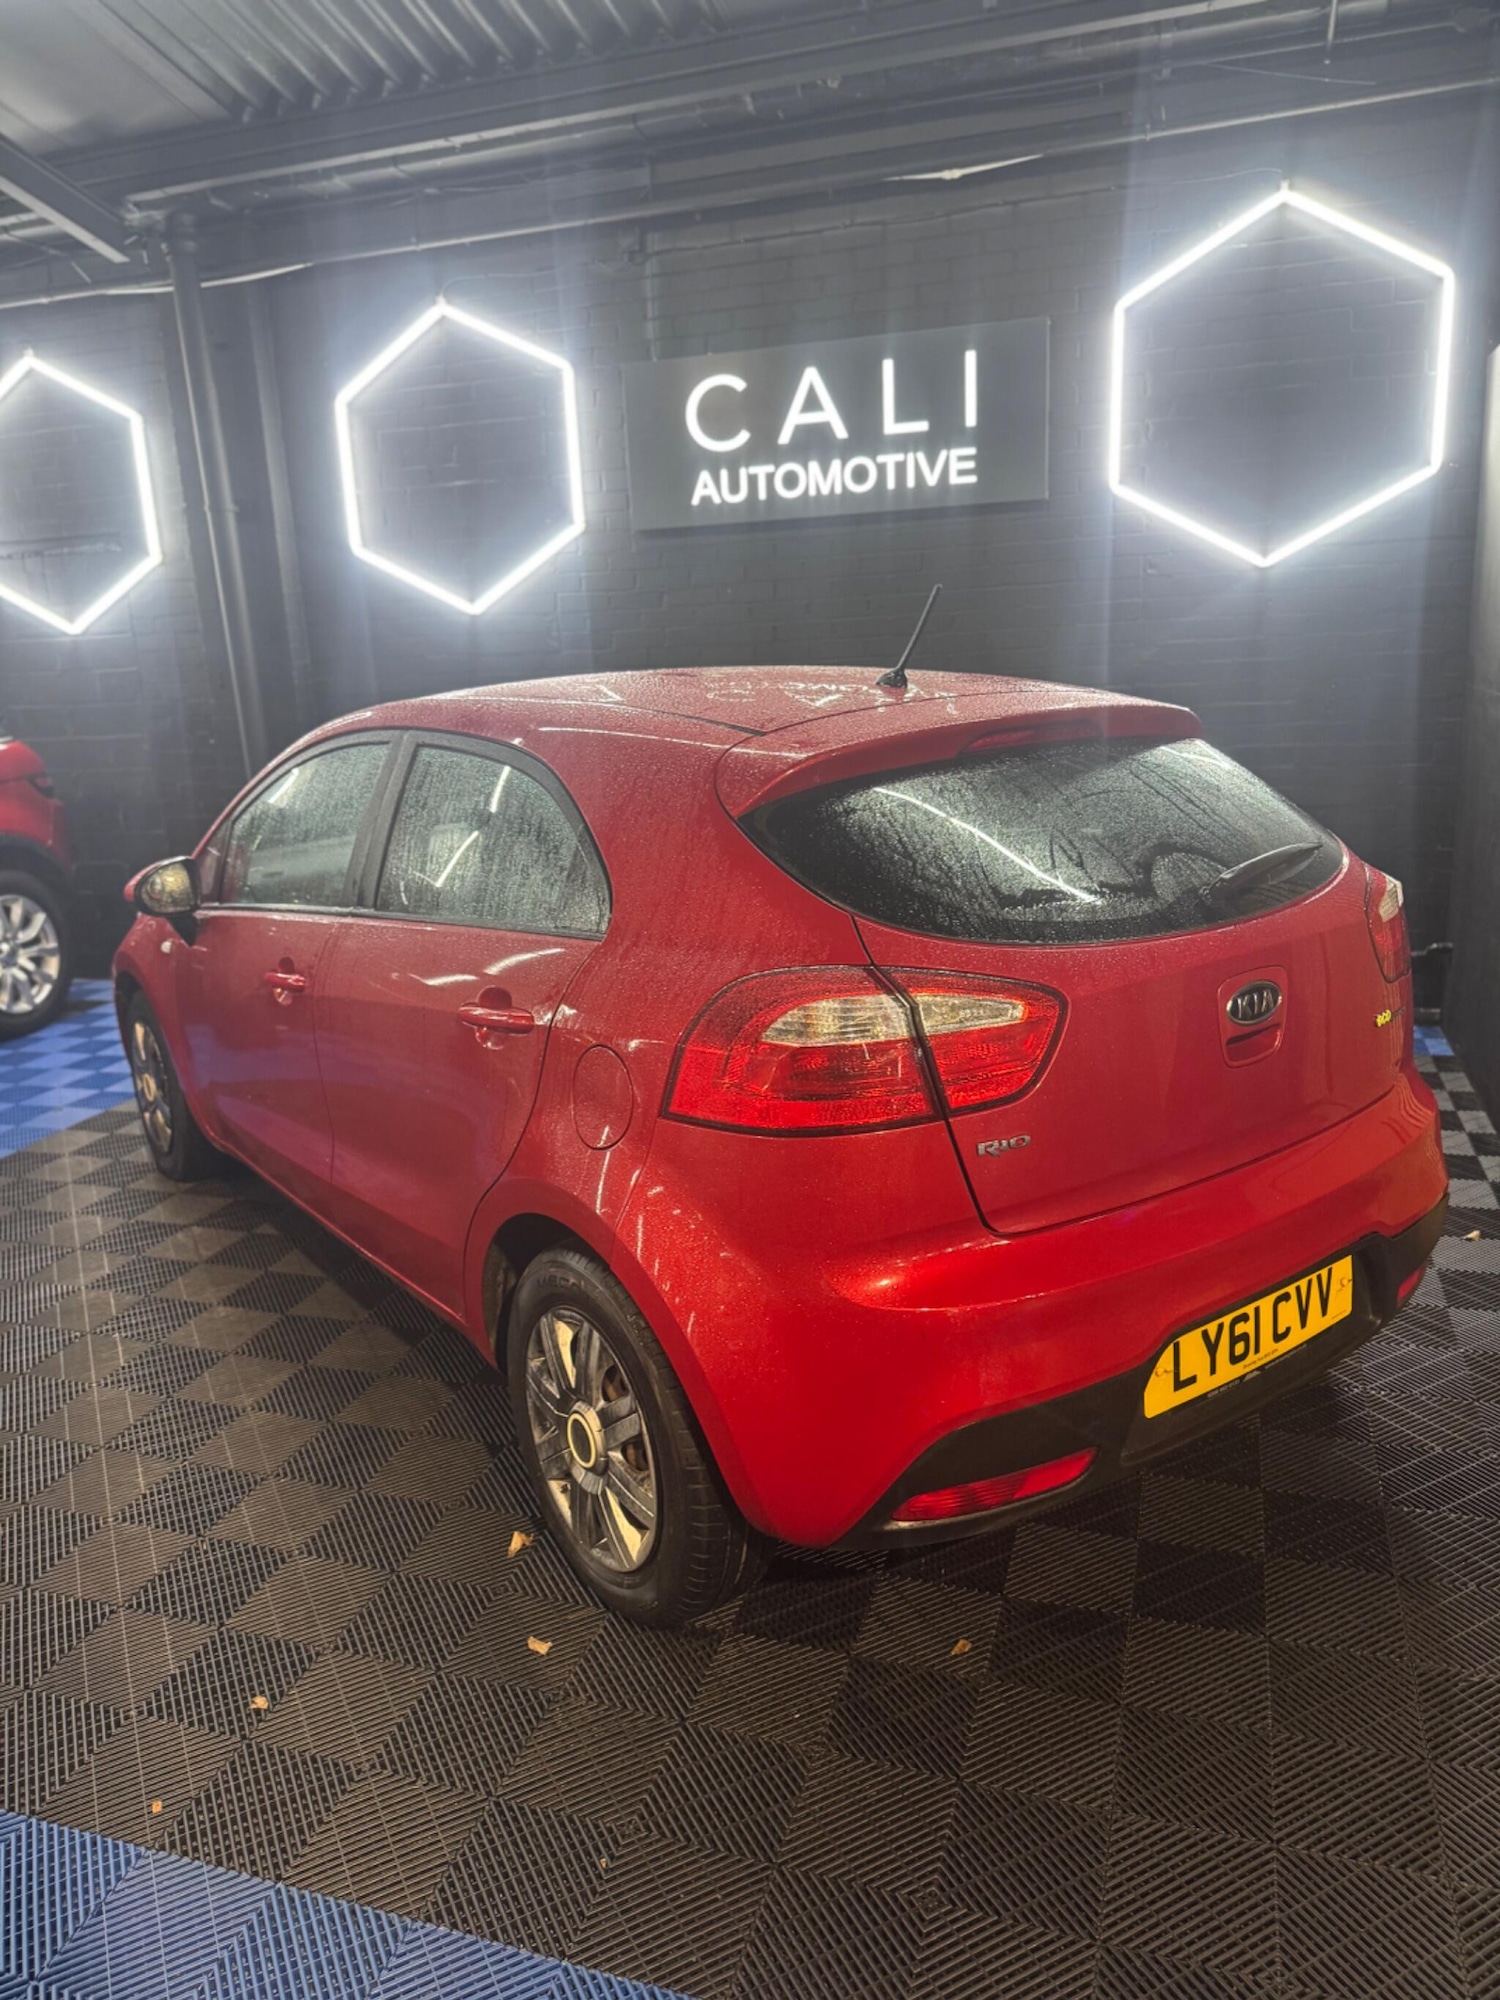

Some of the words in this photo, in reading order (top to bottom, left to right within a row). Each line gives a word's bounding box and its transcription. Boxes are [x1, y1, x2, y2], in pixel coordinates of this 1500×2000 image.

[685, 349, 978, 452] CALI
[690, 446, 979, 507] AUTOMOTIVE
[1236, 989, 1275, 1019] KIA
[976, 1134, 1032, 1158] RIO
[1172, 1304, 1261, 1394] LY61
[1272, 1266, 1334, 1345] CVV
